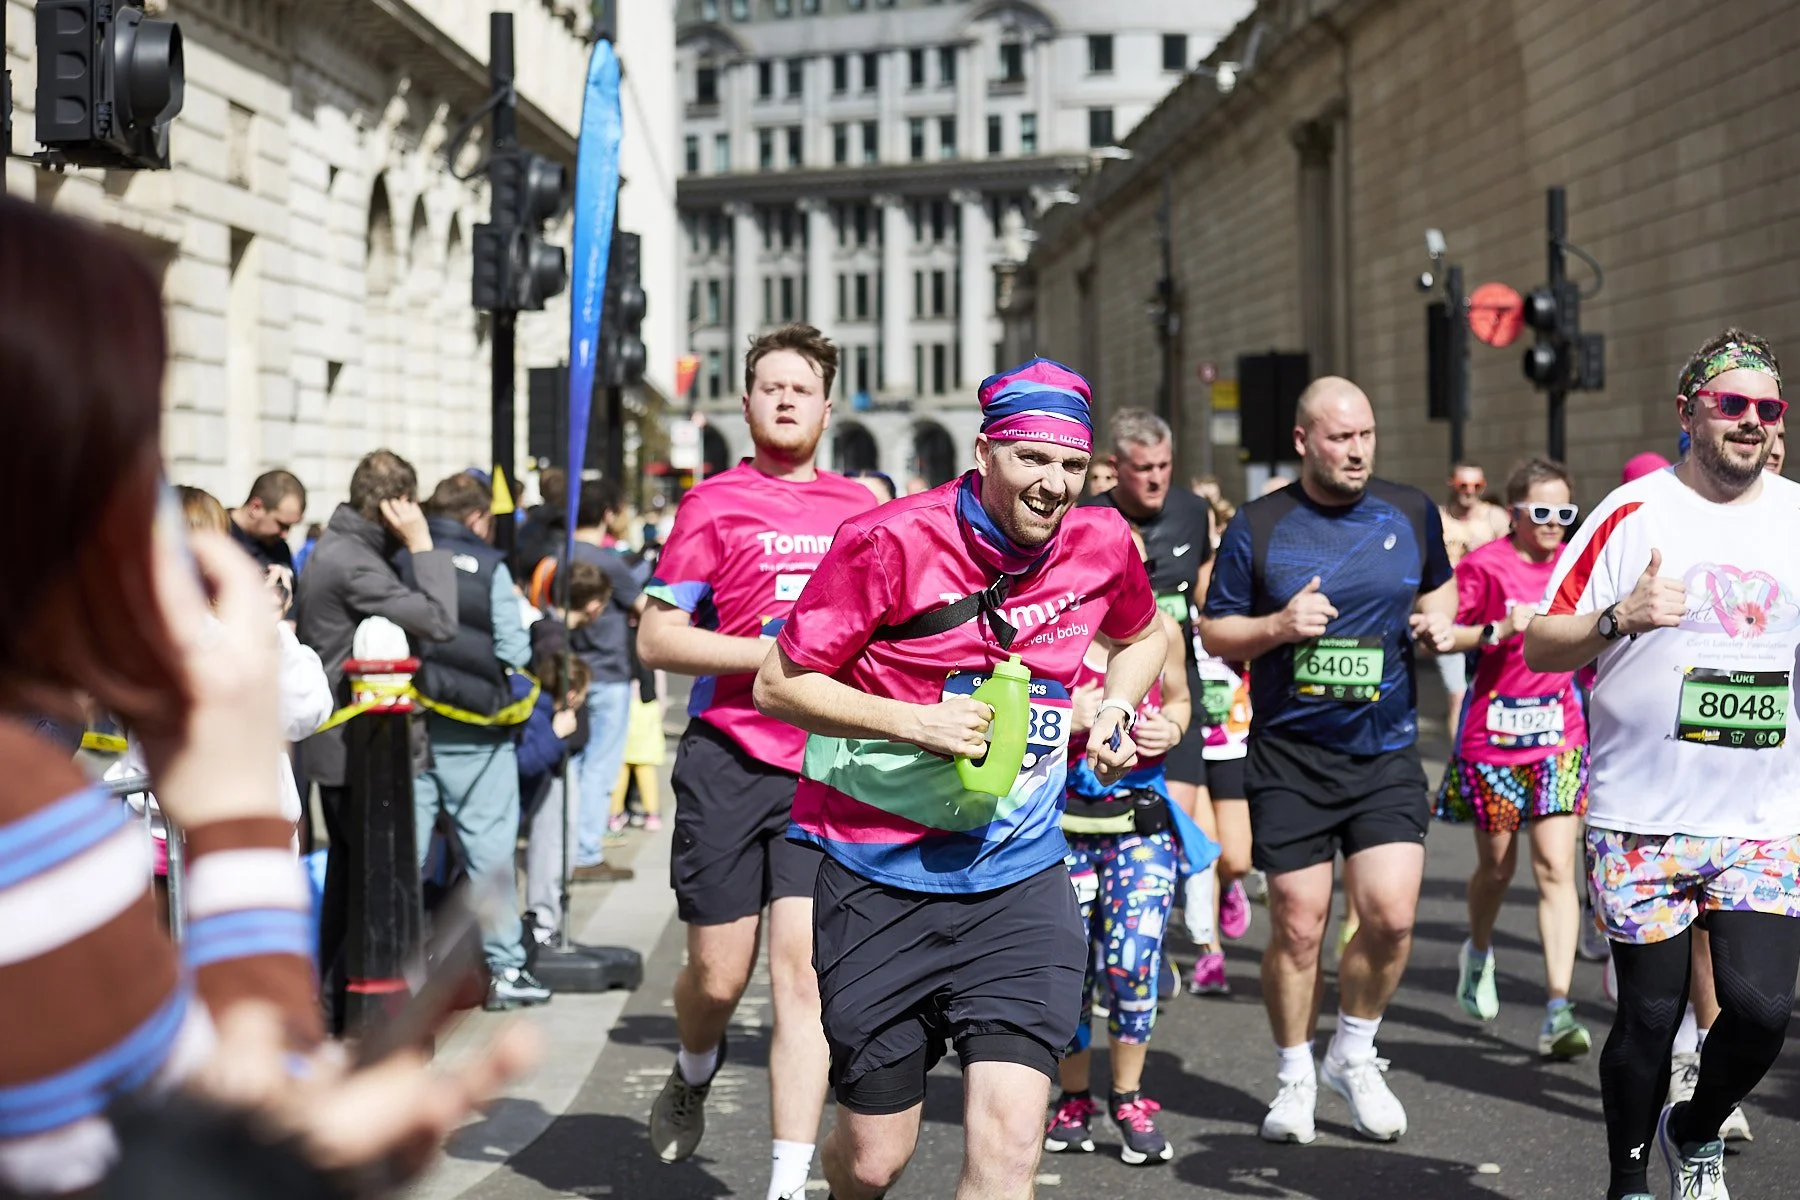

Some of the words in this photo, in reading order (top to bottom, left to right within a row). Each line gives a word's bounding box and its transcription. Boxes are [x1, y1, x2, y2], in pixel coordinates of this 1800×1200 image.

[1059, 434, 1089, 449] Team
[1057, 623, 1089, 638] baby
[1307, 655, 1369, 677] 6405
[1730, 674, 1755, 684] LUKE
[1699, 692, 1775, 721] 8048
[1496, 710, 1557, 730] 11927
